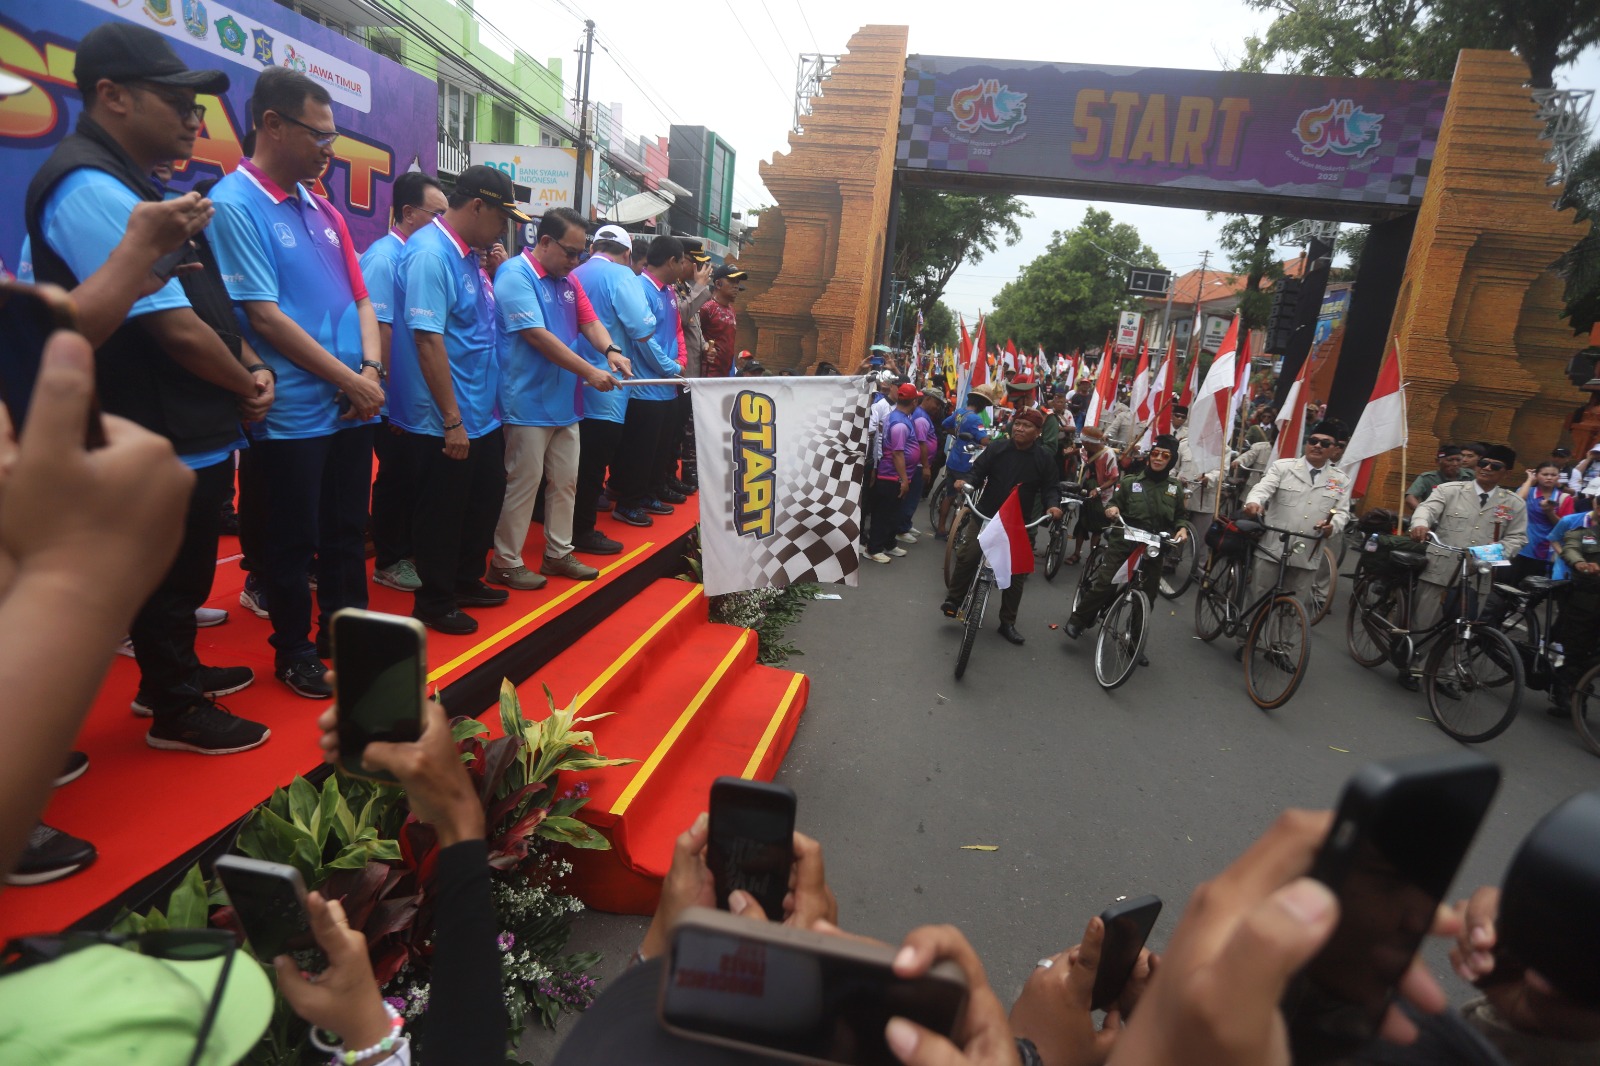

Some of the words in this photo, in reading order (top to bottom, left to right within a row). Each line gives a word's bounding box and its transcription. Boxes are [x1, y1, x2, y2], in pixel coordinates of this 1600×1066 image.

[309, 64, 334, 82] JAWA
[335, 74, 362, 93] TIMUR
[1071, 88, 1252, 168] START
[972, 148, 992, 156] 2025
[519, 168, 538, 176] BANK
[540, 168, 569, 178] SYARIAH
[1317, 173, 1338, 181] 2025
[519, 176, 558, 184] INDONESIA
[539, 189, 567, 202] ATM
[735, 391, 775, 538] START
